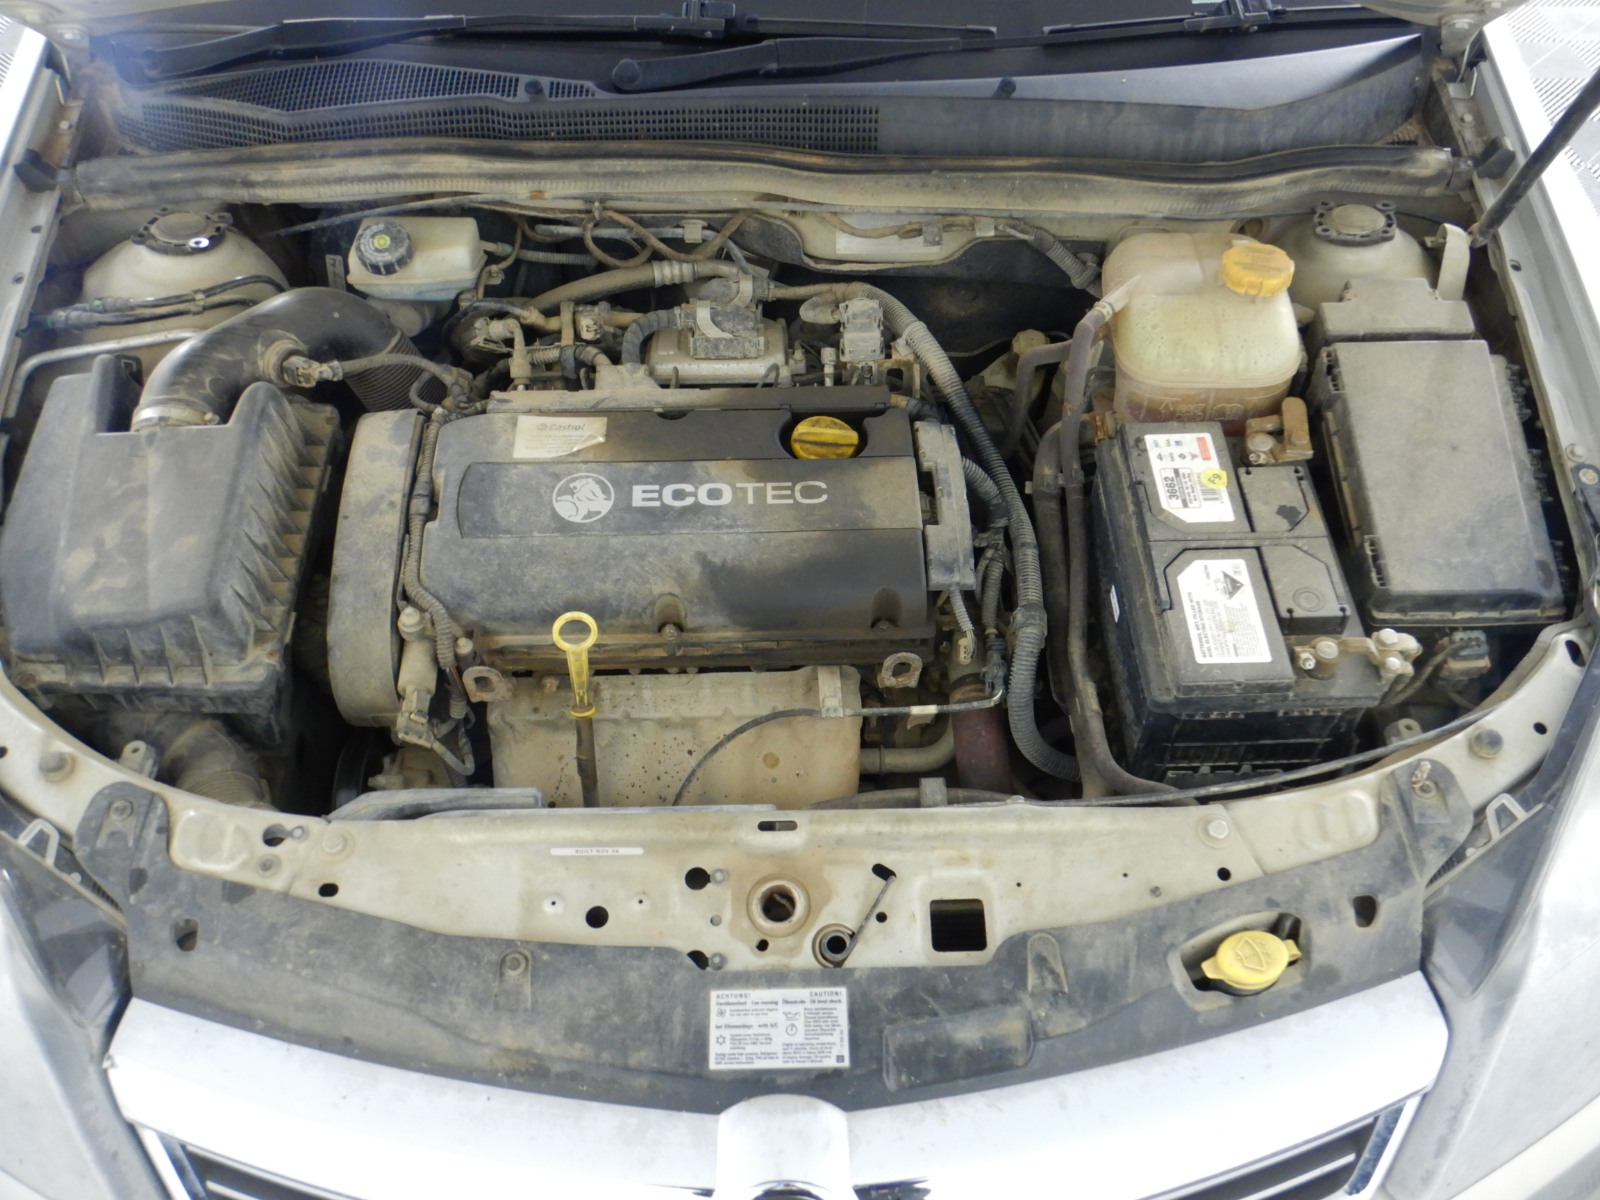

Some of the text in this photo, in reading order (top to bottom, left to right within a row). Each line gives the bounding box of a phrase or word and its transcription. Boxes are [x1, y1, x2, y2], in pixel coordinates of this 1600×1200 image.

[549, 423, 586, 431] Castrol
[632, 481, 828, 507] ECOTEC
[1164, 476, 1179, 500] 3662
